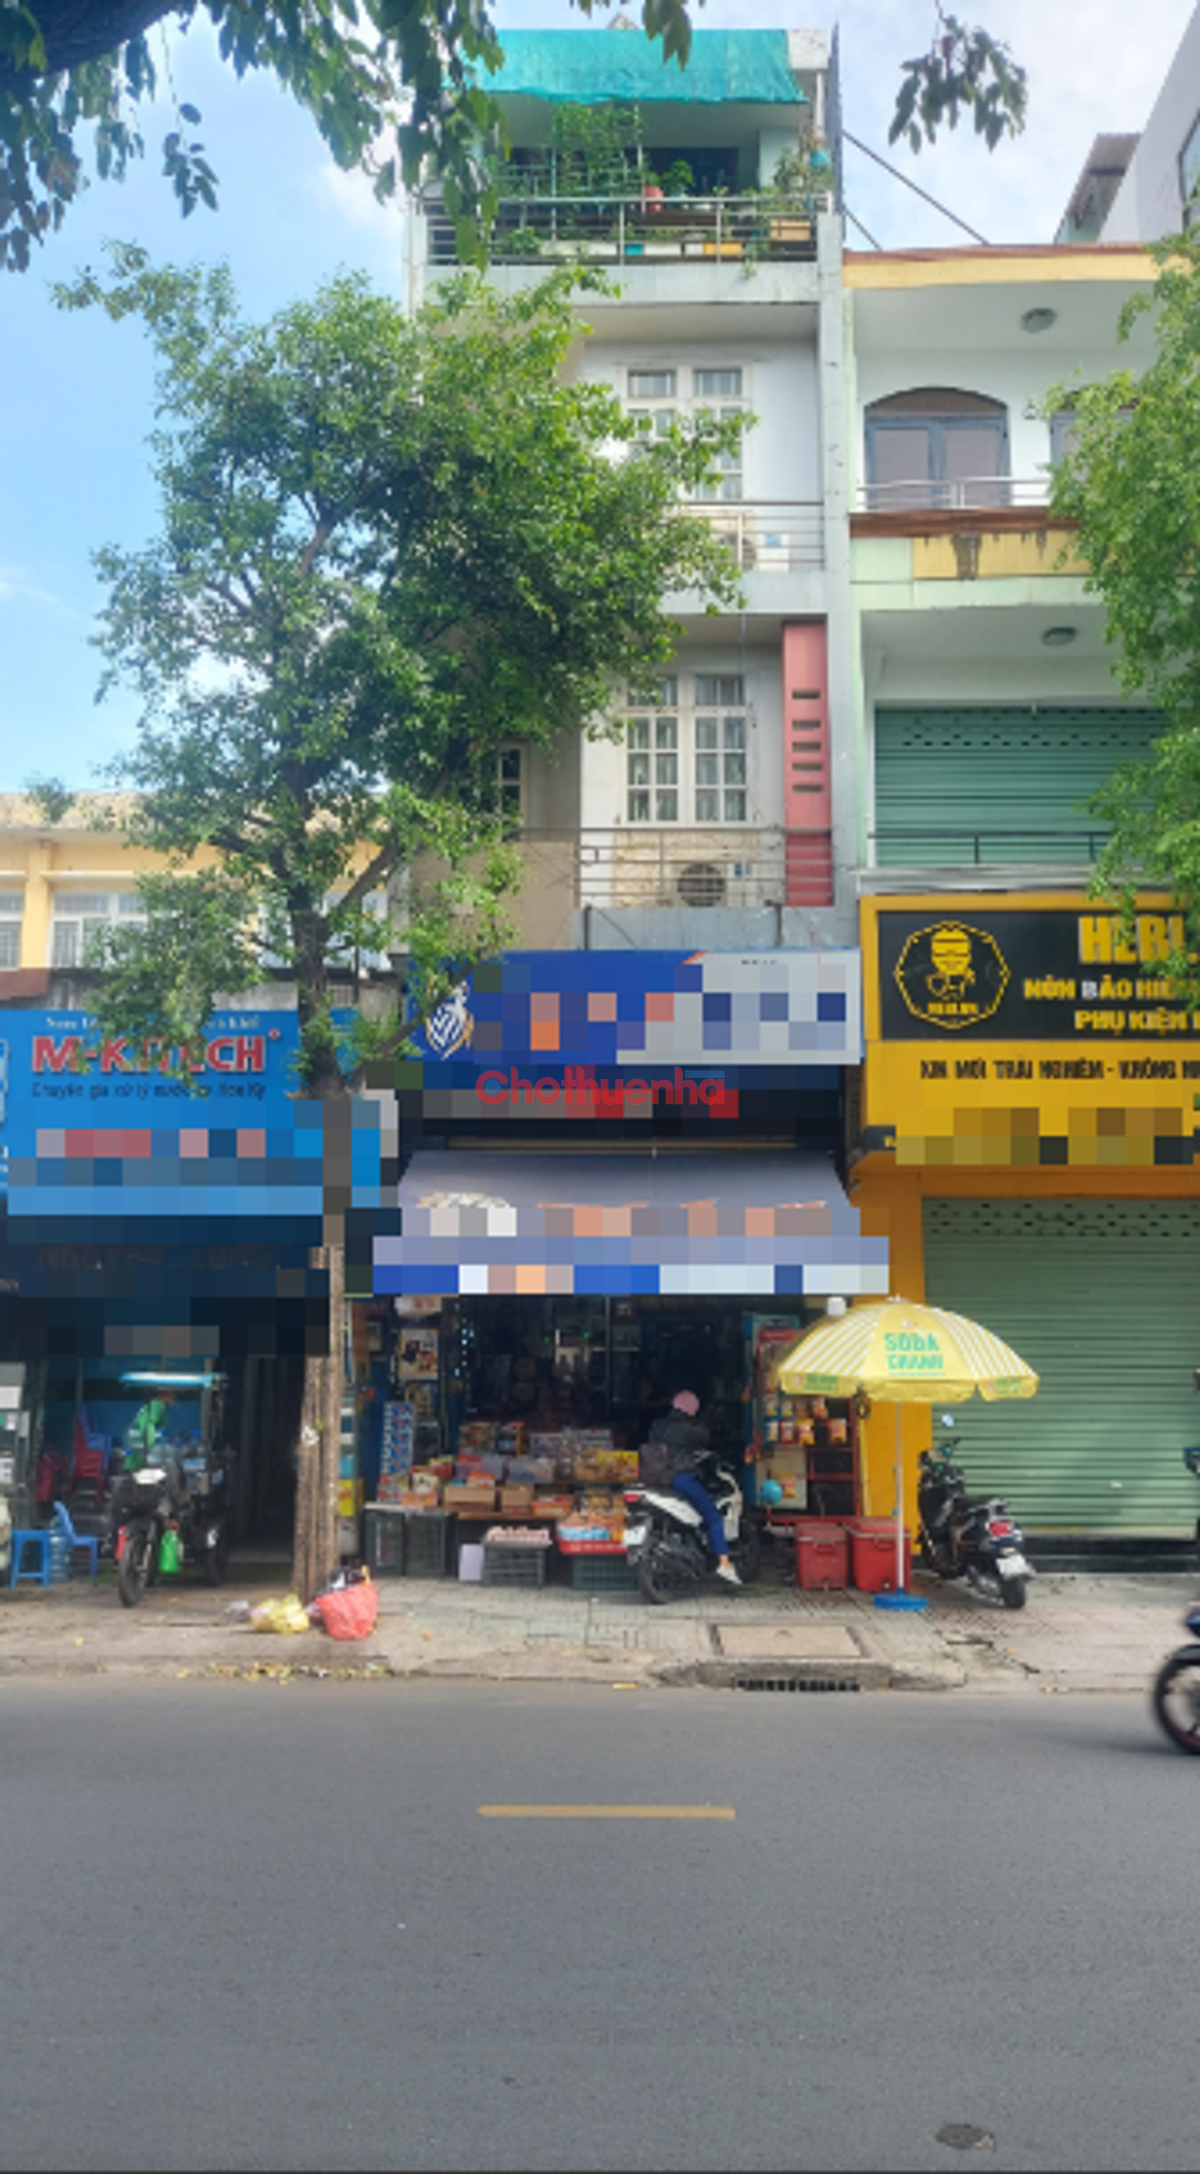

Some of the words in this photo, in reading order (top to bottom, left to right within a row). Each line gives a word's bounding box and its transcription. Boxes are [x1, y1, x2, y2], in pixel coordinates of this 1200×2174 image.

[1024, 974, 1076, 999] NÓN
[1075, 1009, 1126, 1036] PHỤ
[1128, 1006, 1188, 1036] KIỆN
